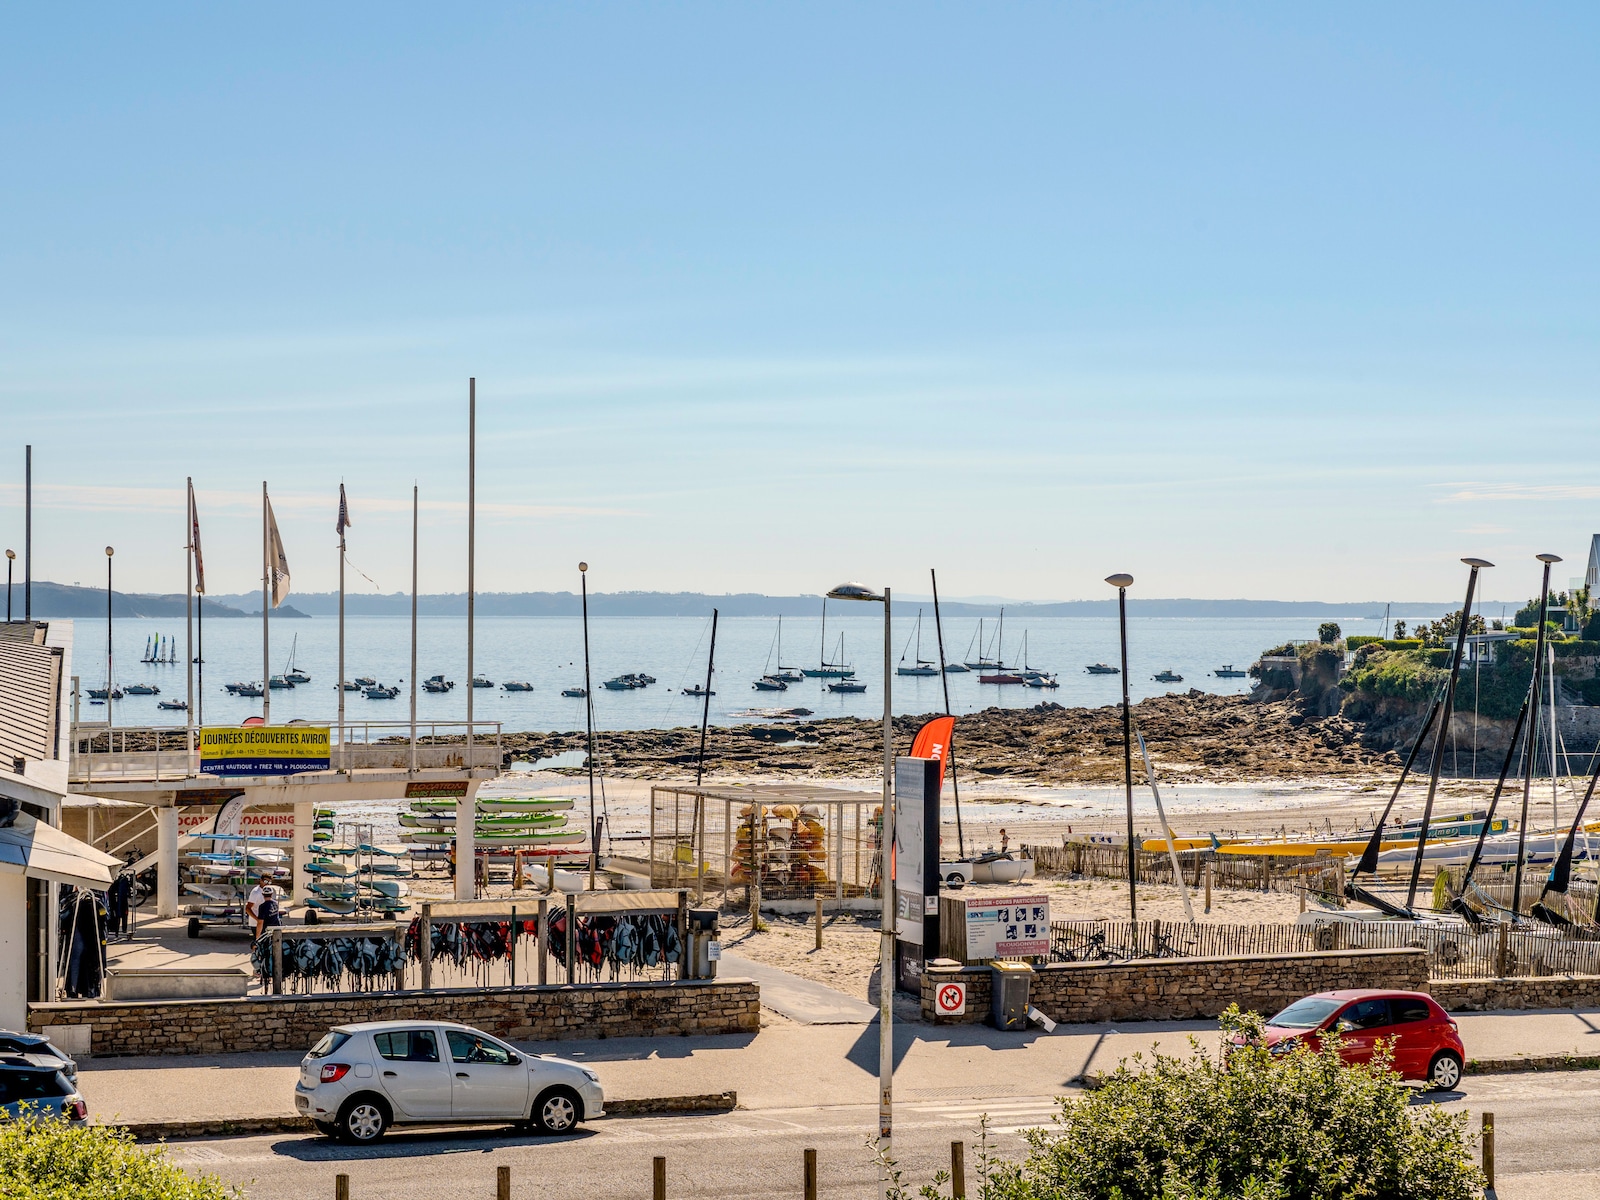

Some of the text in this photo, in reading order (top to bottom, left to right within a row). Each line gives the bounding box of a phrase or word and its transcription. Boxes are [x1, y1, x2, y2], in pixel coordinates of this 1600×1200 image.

[203, 730, 328, 745] JOURNÉES DÉCOUVERTES AVIRON
